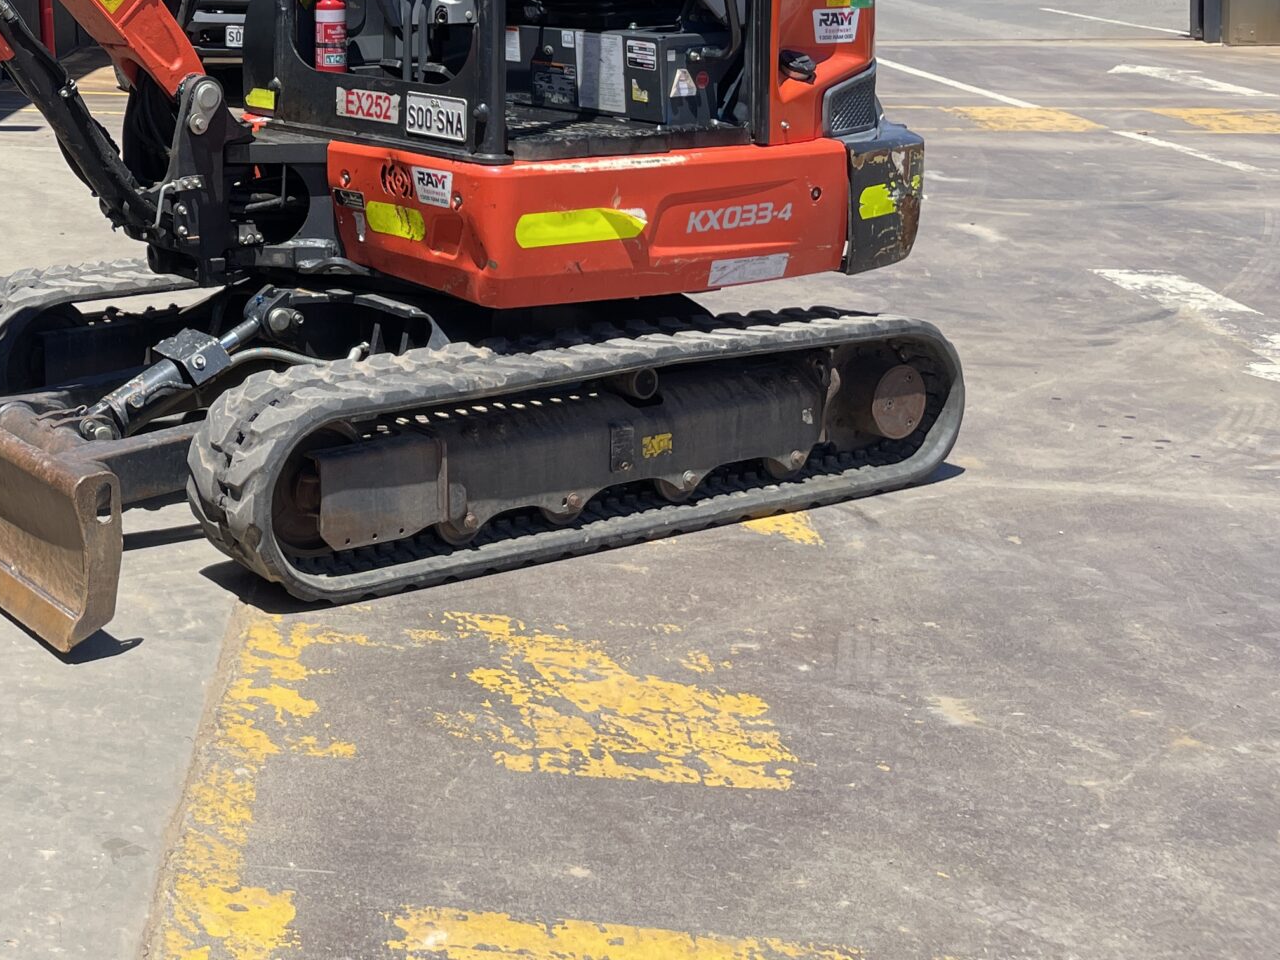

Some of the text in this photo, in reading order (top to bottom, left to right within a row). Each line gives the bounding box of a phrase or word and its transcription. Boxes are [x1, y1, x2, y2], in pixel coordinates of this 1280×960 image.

[818, 11, 855, 27] RAM
[345, 90, 392, 120] EX252
[416, 170, 448, 190] RAM
[686, 202, 793, 234] KX033-4
